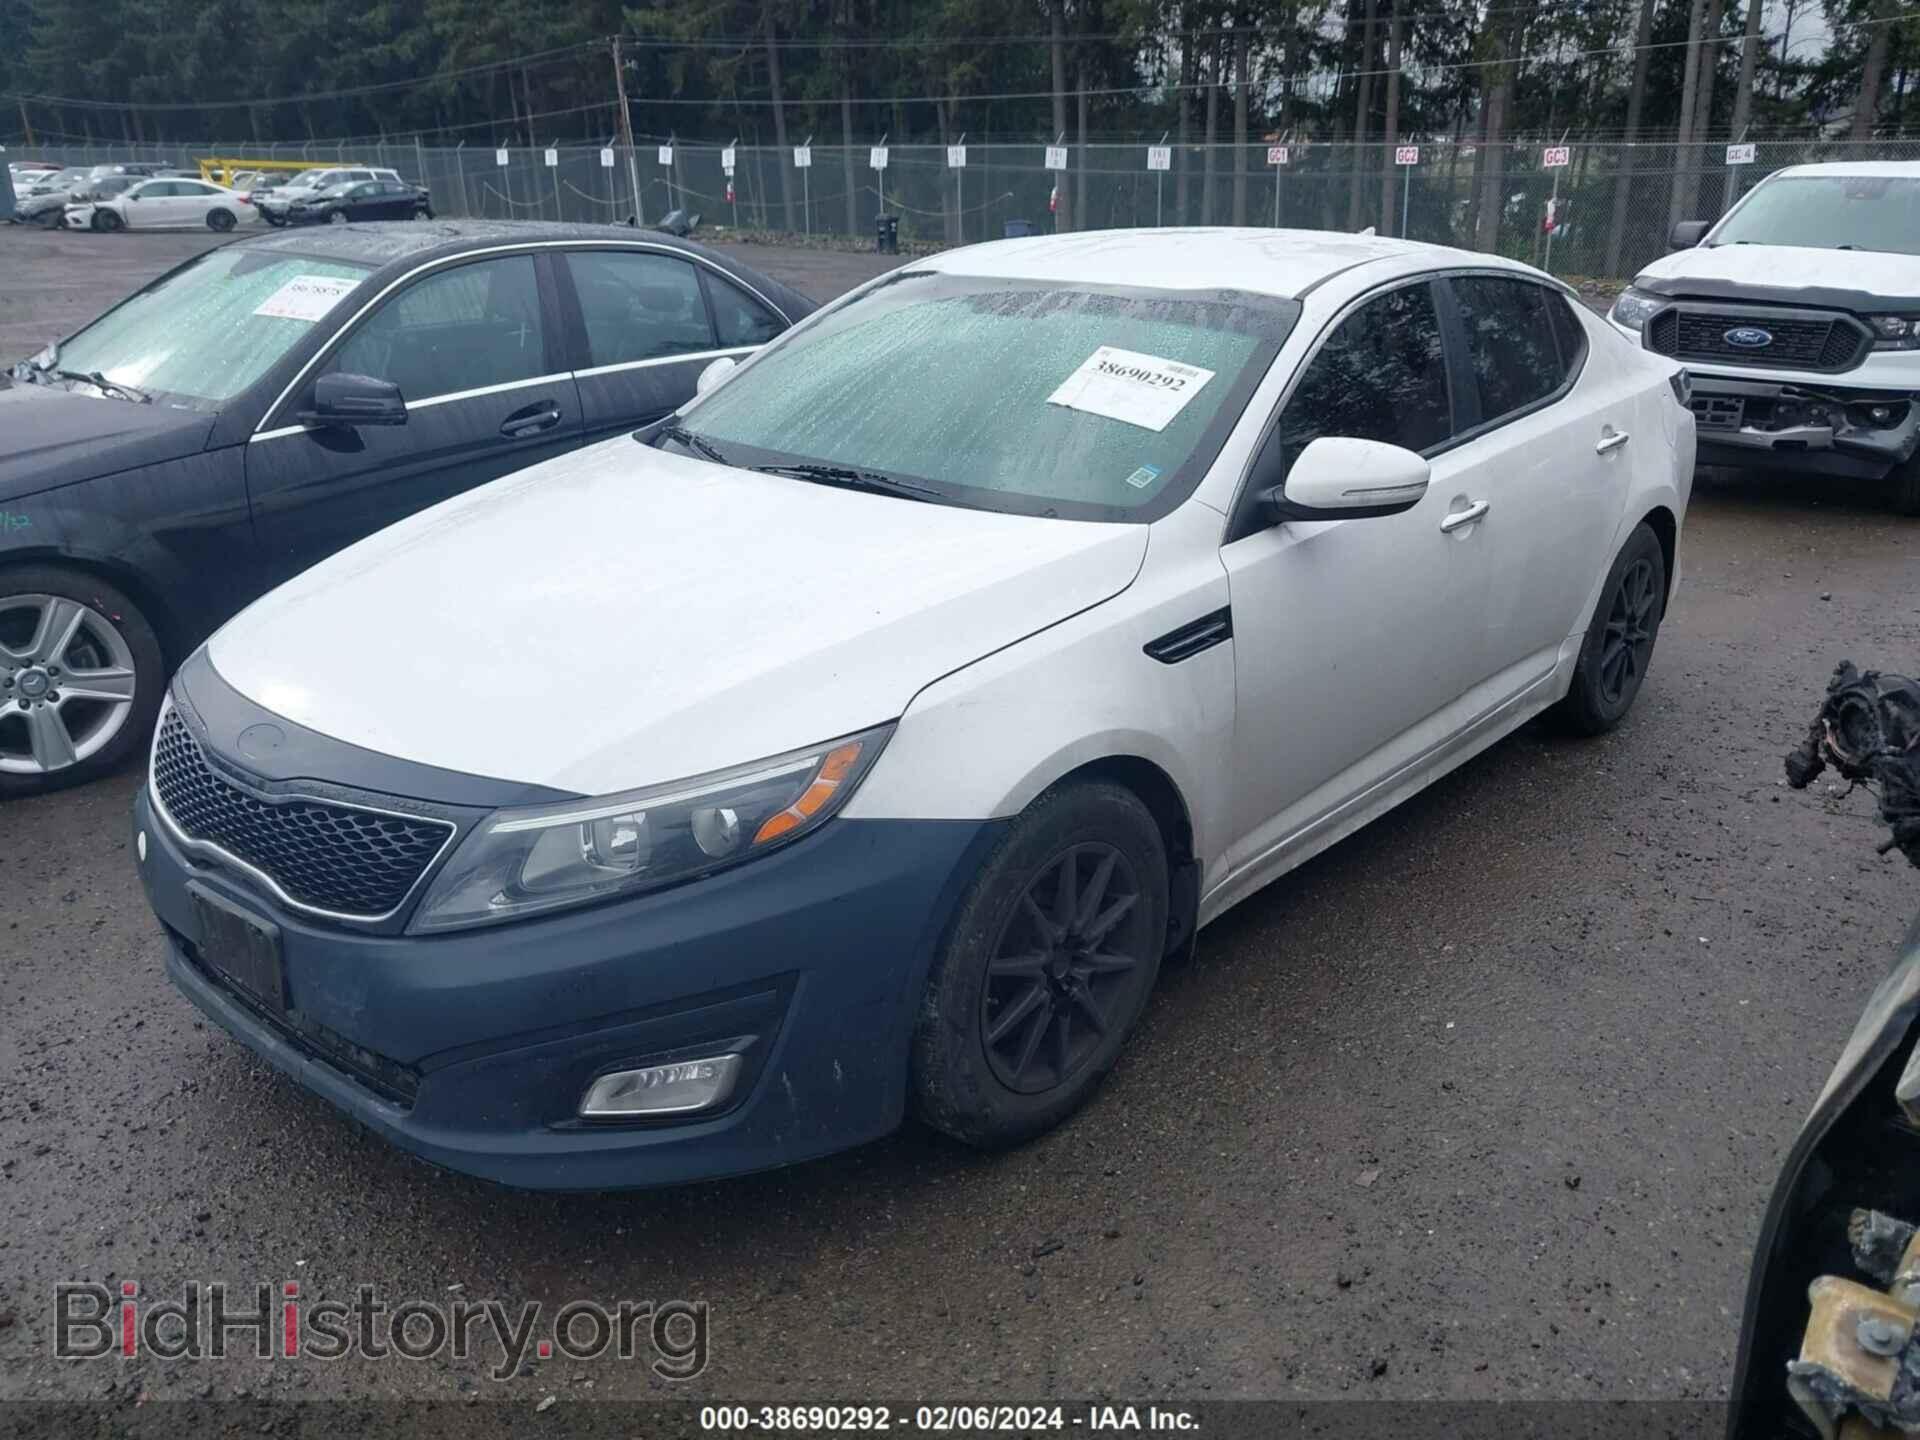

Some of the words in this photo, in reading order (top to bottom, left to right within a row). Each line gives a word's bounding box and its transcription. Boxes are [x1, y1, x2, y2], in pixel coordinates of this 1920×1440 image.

[1269, 148, 1287, 161] GC1
[1398, 148, 1417, 161] GC2
[1546, 150, 1568, 164] GC3
[1093, 360, 1187, 392] 38690292
